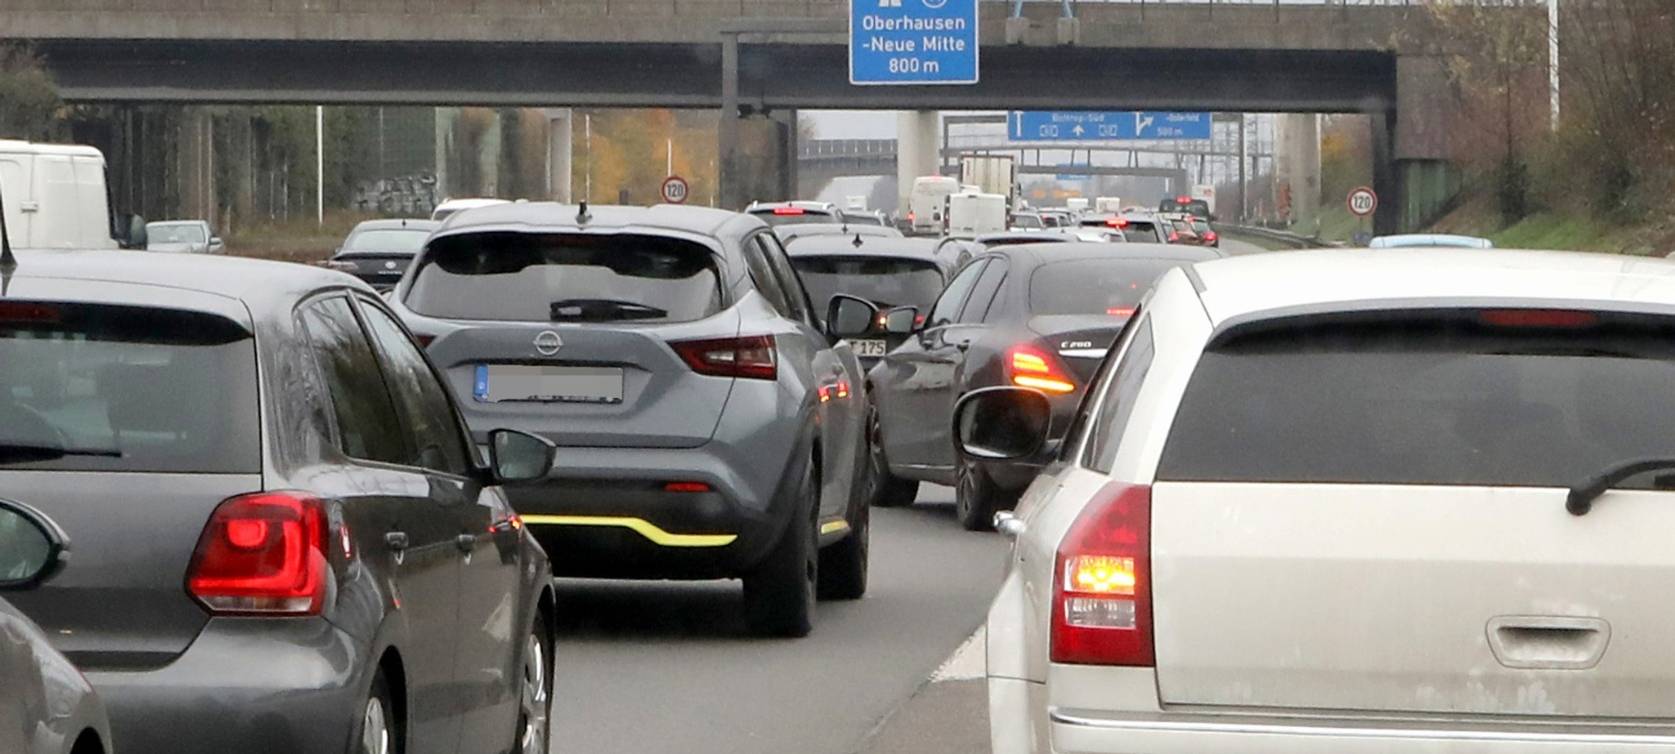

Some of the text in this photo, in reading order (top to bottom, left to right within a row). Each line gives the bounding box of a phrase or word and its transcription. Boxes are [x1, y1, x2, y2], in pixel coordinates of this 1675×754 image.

[863, 15, 965, 30] Oberhausen
[863, 36, 965, 52] -Neue Mitte
[889, 58, 939, 73] 800 m
[667, 183, 683, 197] 120
[1354, 196, 1370, 209] 120
[861, 341, 884, 354] 175
